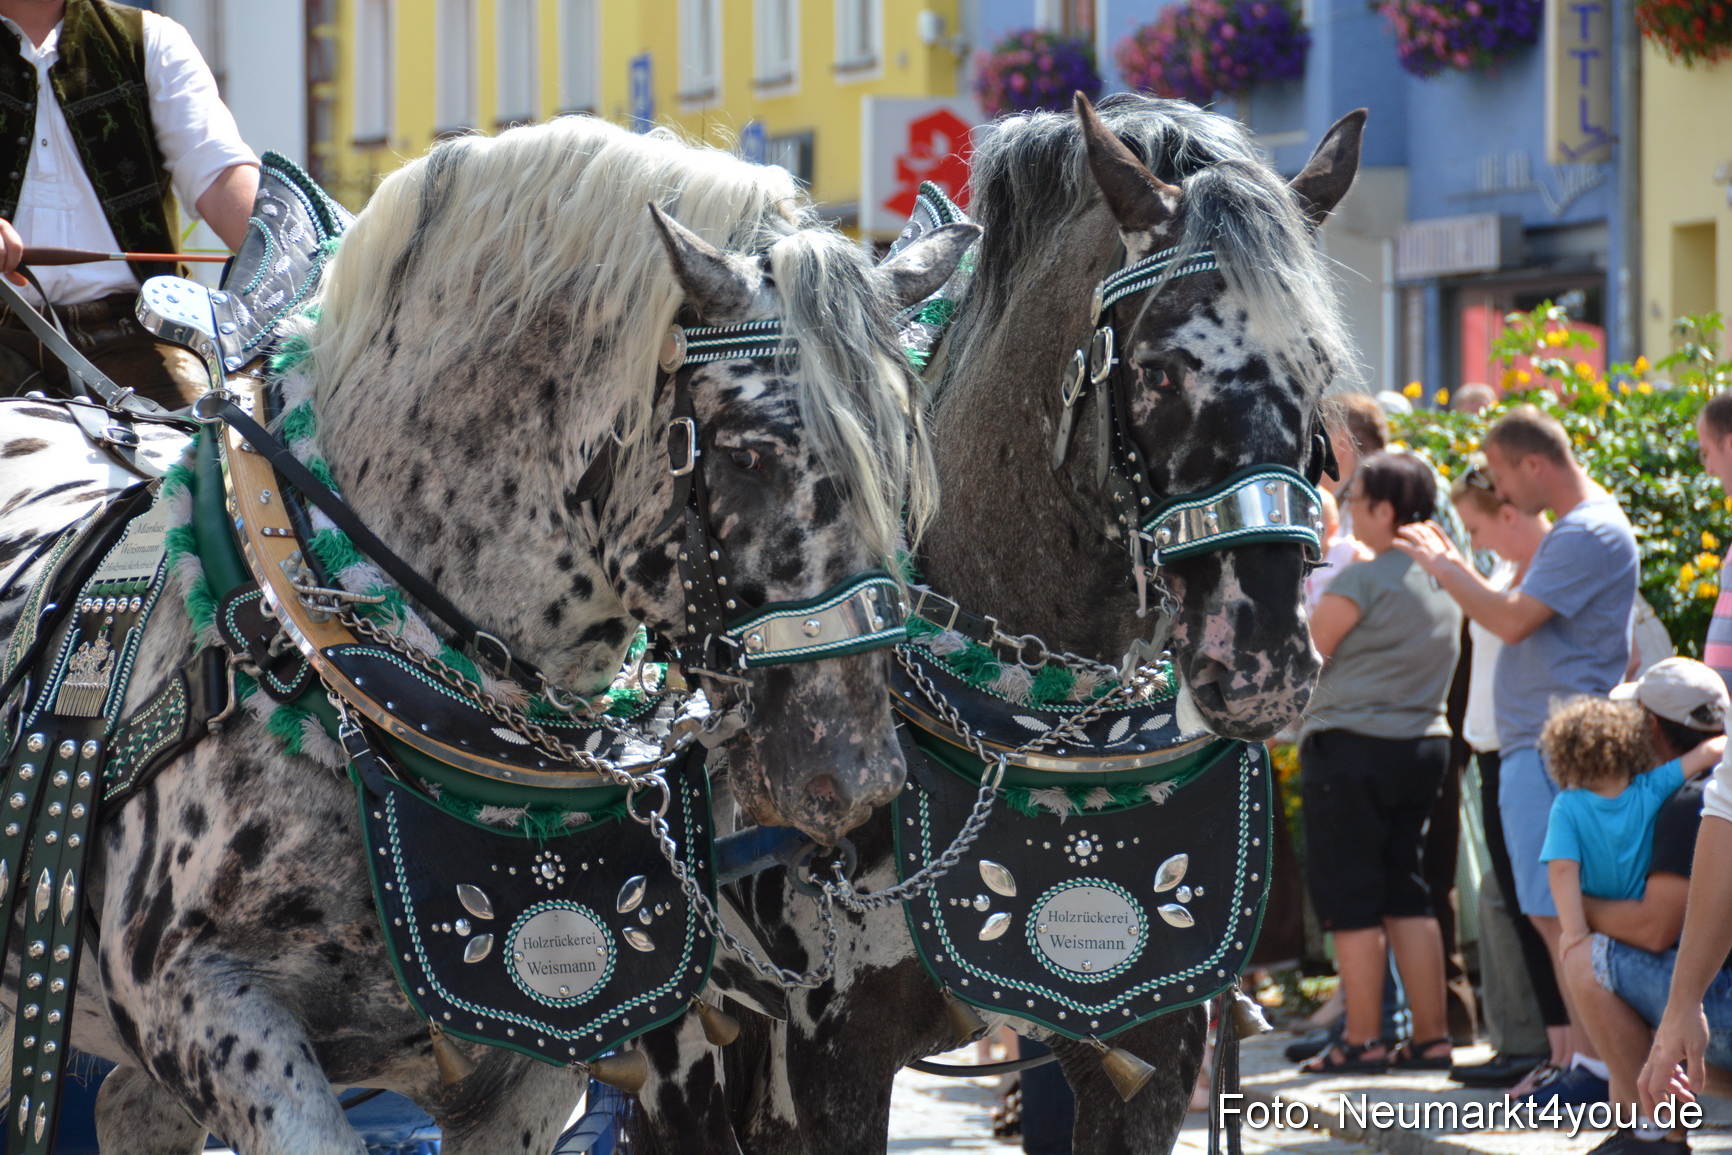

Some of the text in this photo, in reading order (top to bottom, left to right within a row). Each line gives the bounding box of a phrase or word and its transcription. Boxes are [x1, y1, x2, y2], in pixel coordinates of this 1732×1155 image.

[134, 522, 166, 535] Markus
[120, 543, 160, 555] Weismann
[1048, 911, 1128, 924] Holzrückerei
[523, 933, 597, 949] Holzrückerei
[1049, 934, 1125, 950] Weismann
[527, 960, 597, 976] Weismann
